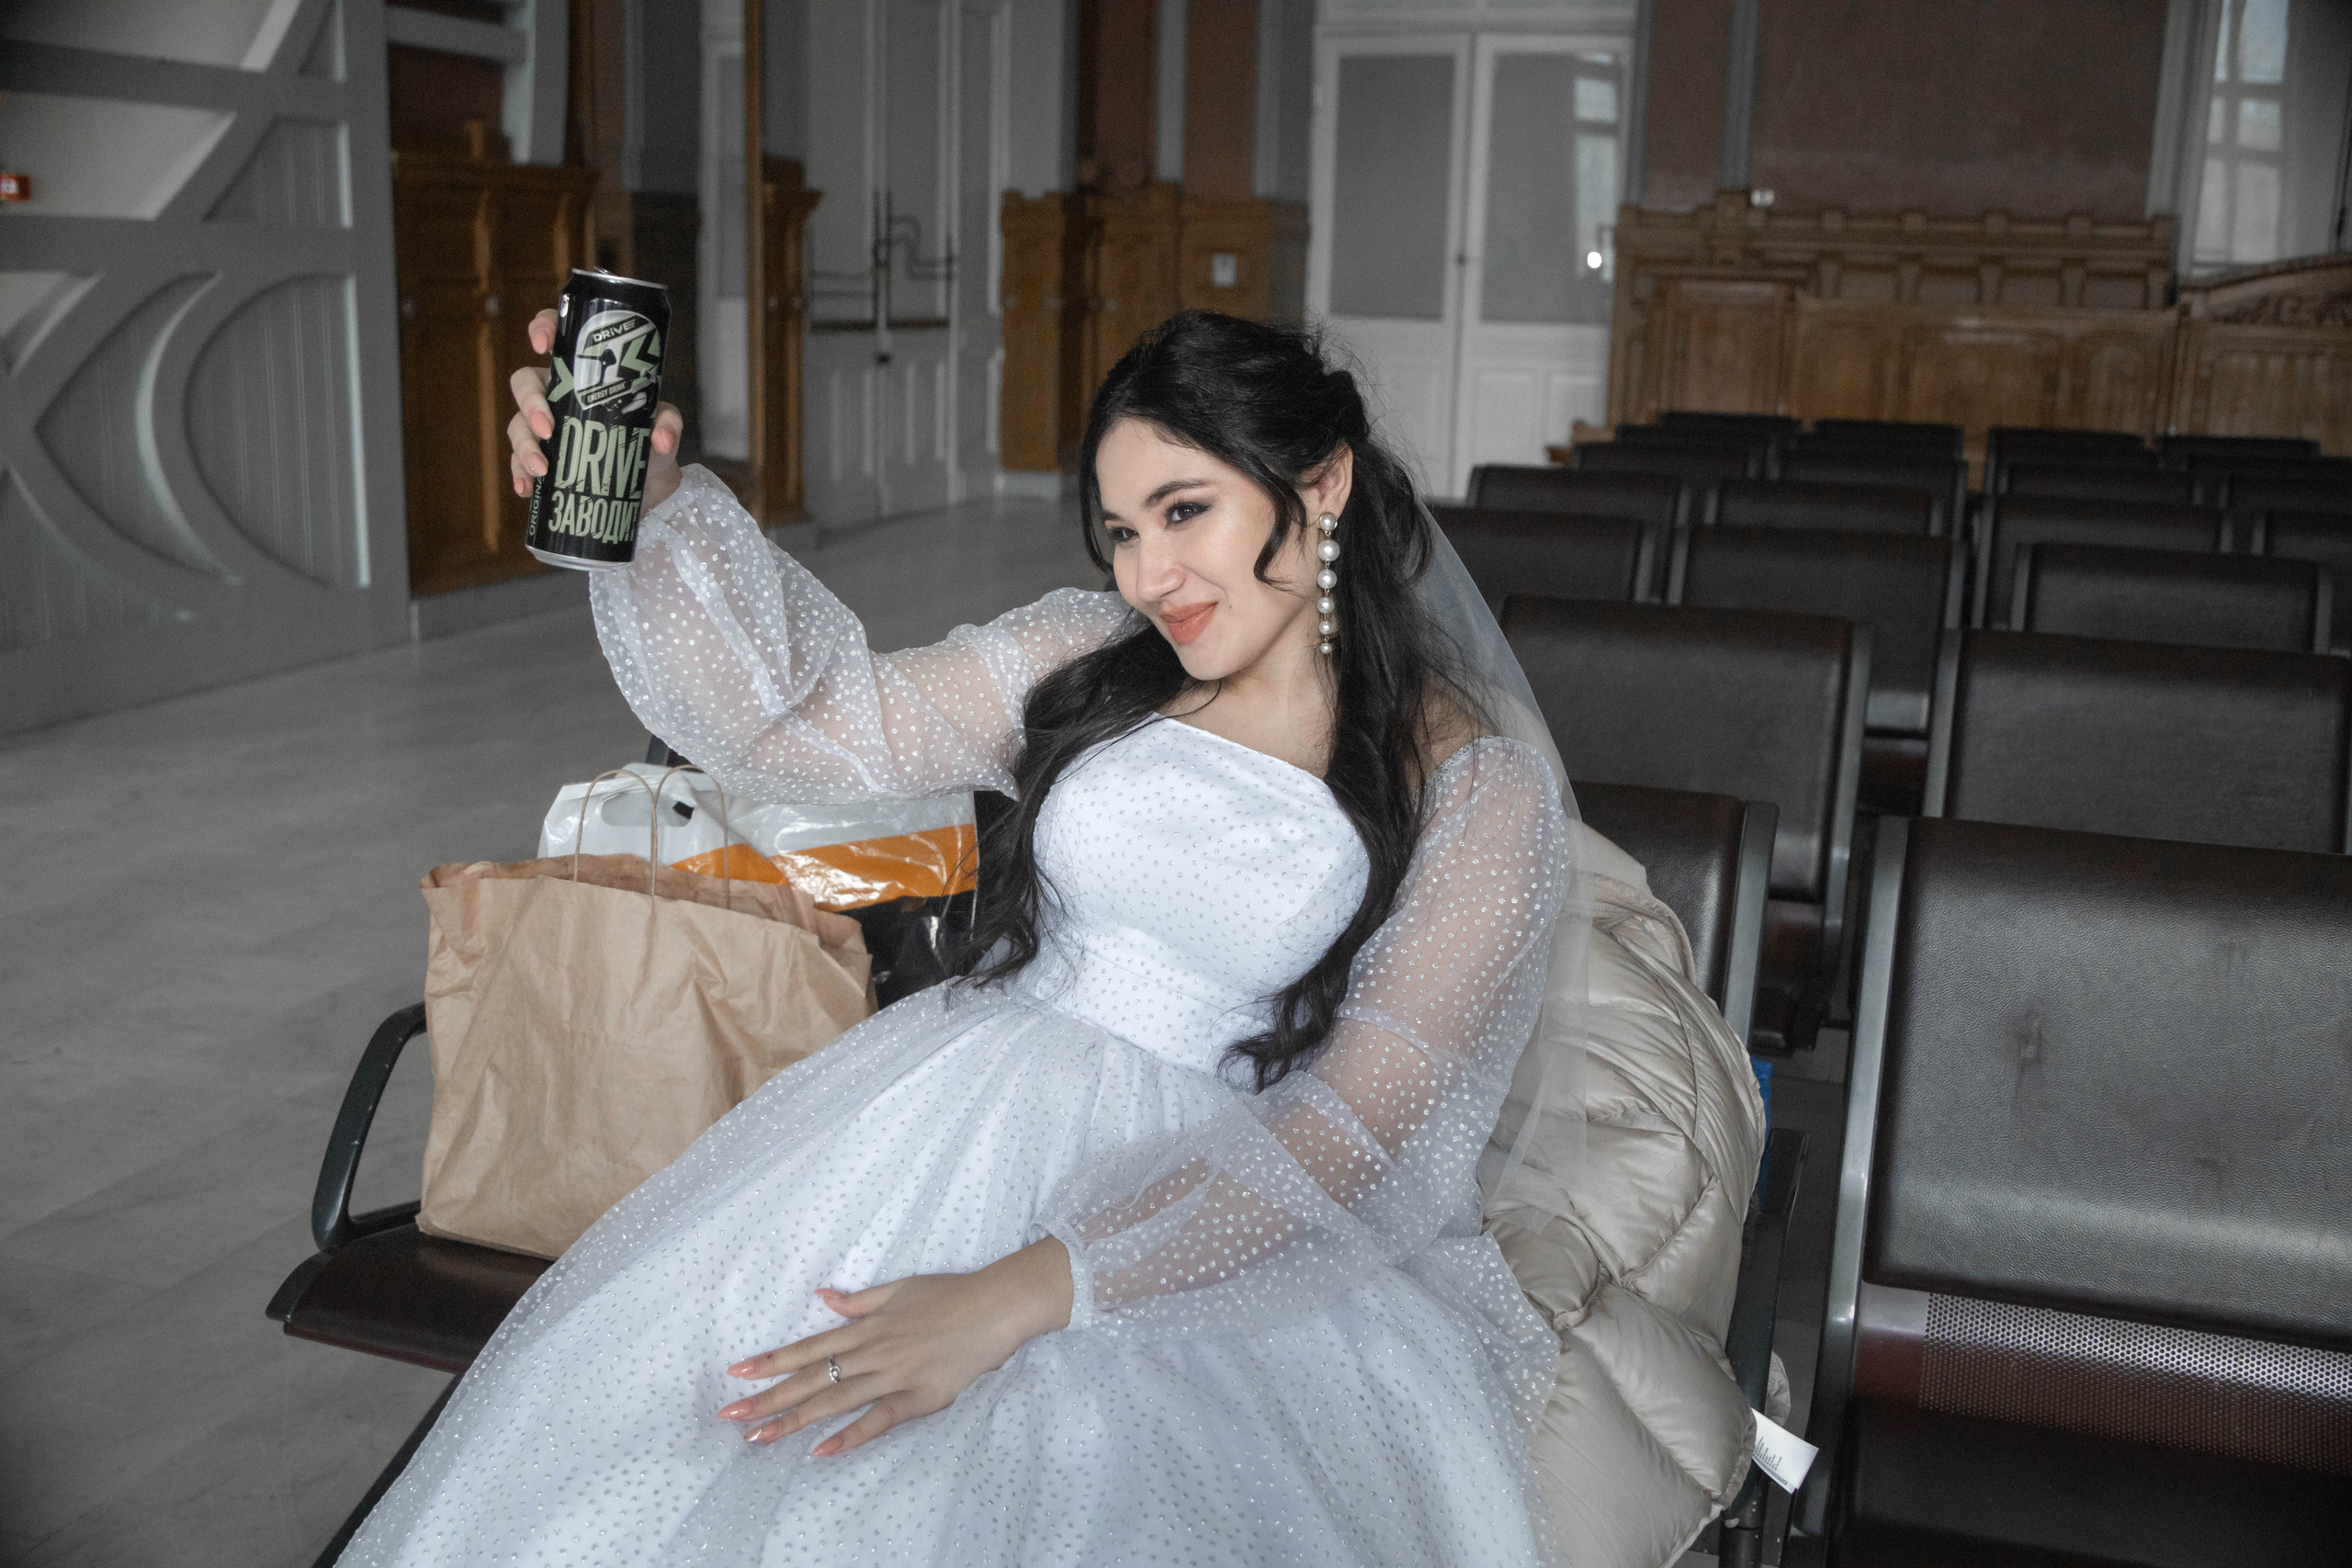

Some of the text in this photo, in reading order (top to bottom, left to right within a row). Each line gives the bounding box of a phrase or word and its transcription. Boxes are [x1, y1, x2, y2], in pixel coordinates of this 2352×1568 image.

[588, 380, 627, 402] ENERGY DRINK
[555, 415, 651, 499] DRIVE
[529, 476, 544, 536] ORIGINA
